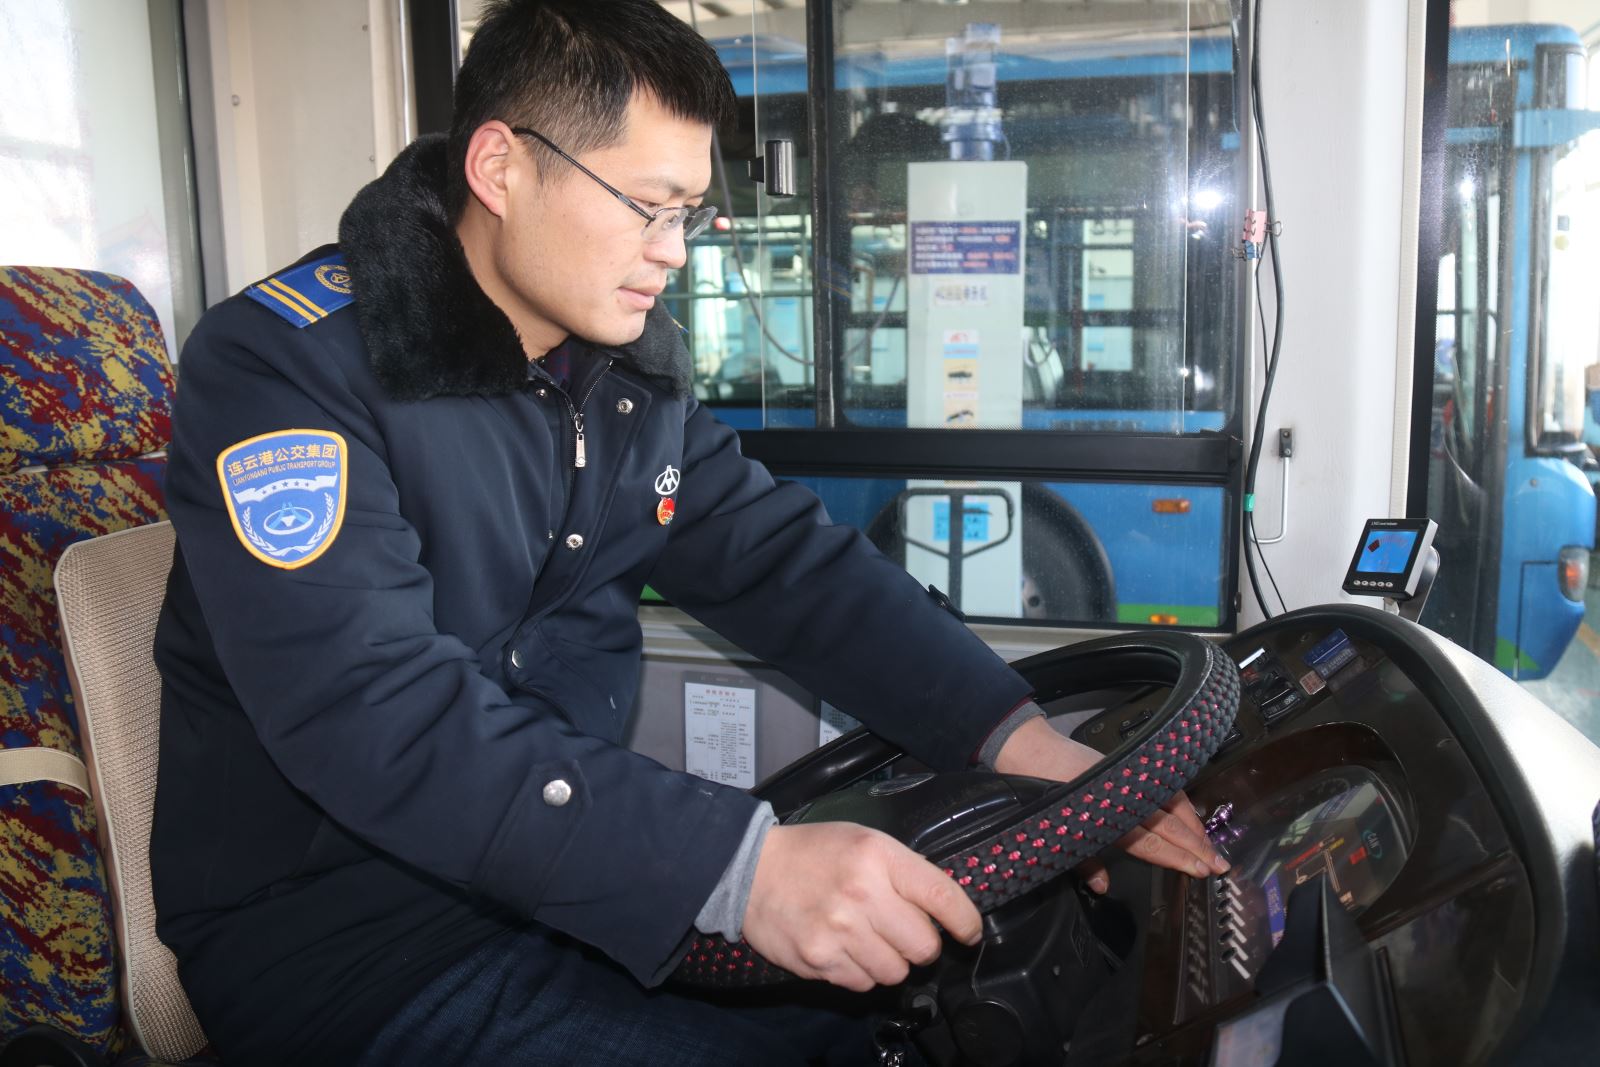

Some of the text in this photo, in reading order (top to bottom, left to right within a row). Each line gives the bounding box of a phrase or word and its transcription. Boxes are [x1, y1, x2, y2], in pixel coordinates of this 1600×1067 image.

[228, 444, 337, 476] 连云港公交集团
[268, 463, 286, 474] PUBLIC
[287, 460, 317, 470] TRANSPORT
